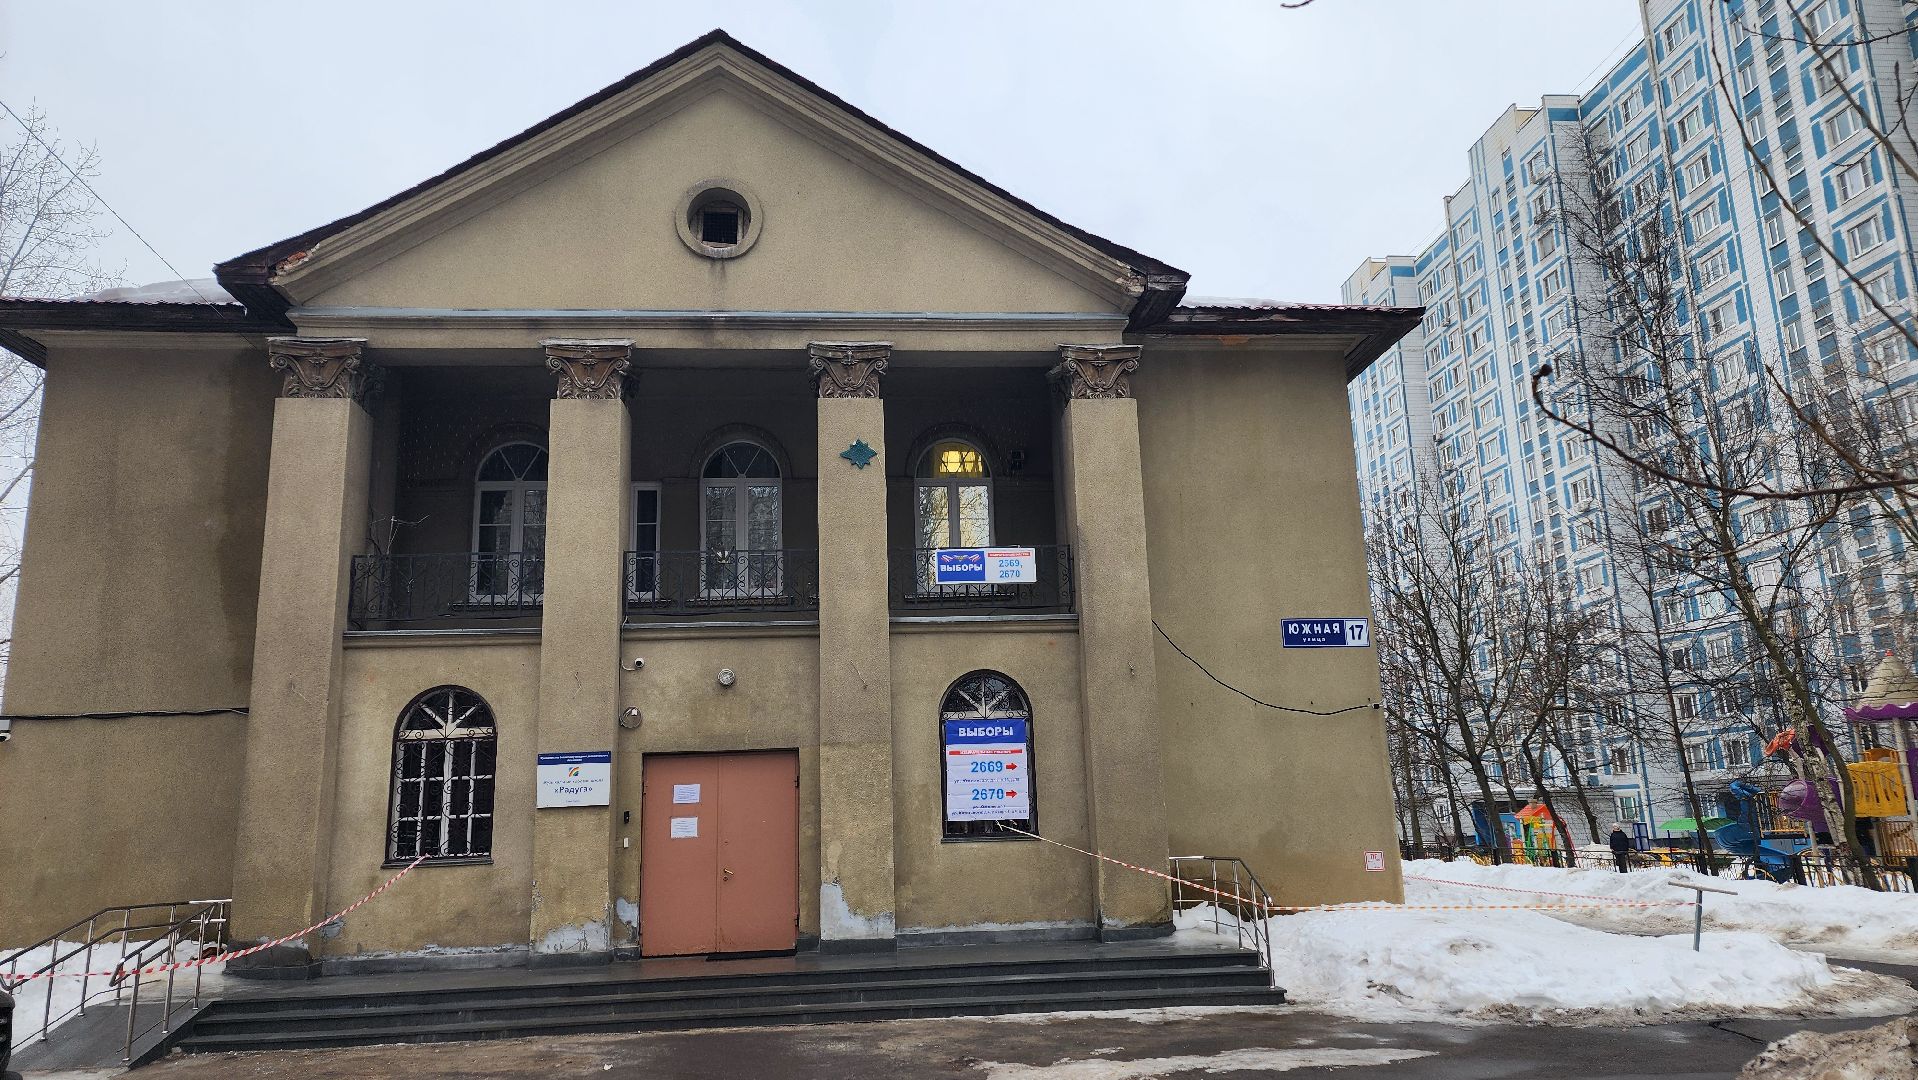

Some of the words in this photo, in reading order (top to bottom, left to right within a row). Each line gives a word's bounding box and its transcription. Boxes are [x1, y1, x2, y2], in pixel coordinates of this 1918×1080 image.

[940, 564, 983, 572] ВЫБОРЫ
[999, 570, 1021, 578] 2670
[1288, 622, 1341, 635] ЮЖНАЯ
[1348, 624, 1364, 640] 17
[958, 726, 1014, 737] ВЫБОРЫ
[970, 761, 1003, 773] 2669
[971, 788, 1004, 801] 2670
